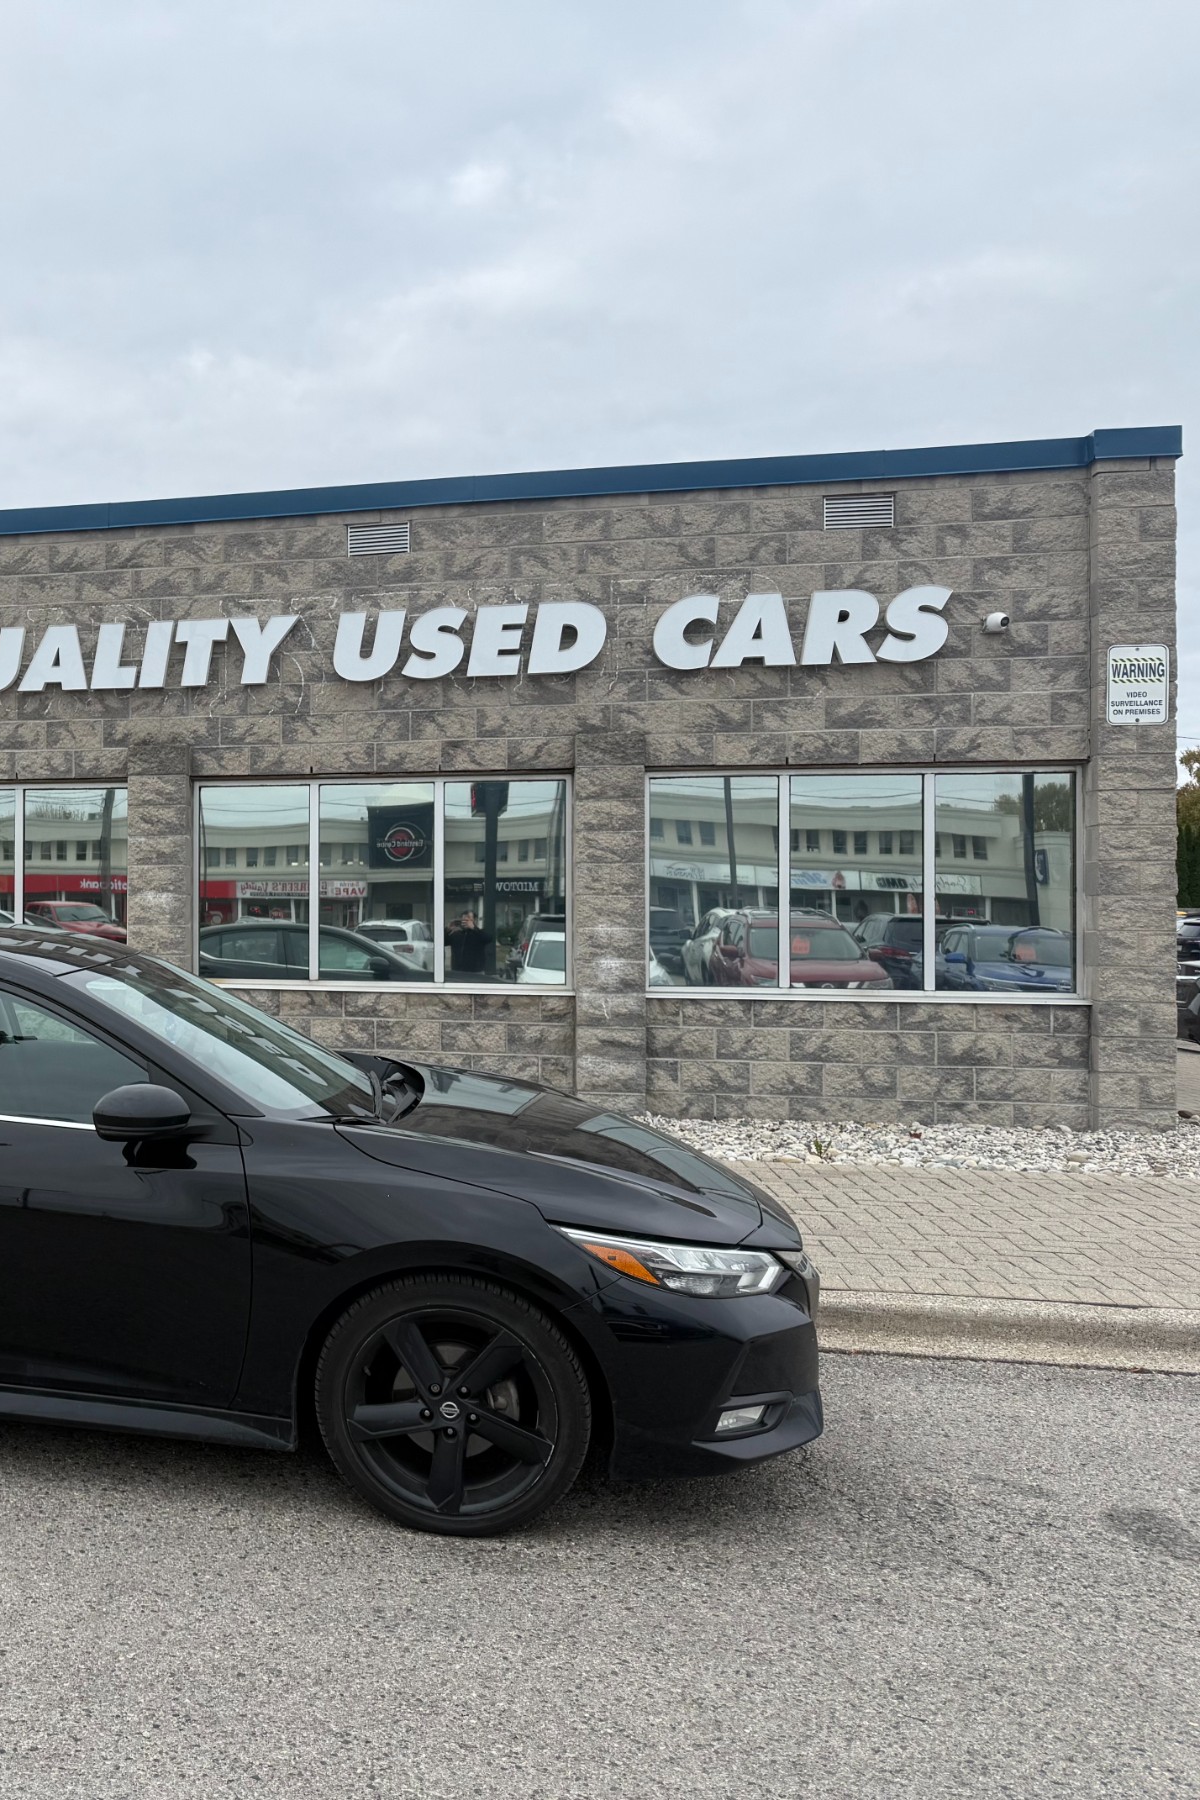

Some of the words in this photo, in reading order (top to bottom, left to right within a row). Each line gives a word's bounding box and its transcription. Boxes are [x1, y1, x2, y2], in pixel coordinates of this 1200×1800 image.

[332, 601, 608, 682] USED
[653, 584, 954, 670] CARS
[1111, 662, 1165, 679] WARNING
[1111, 699, 1163, 707] SURVEILLANCE
